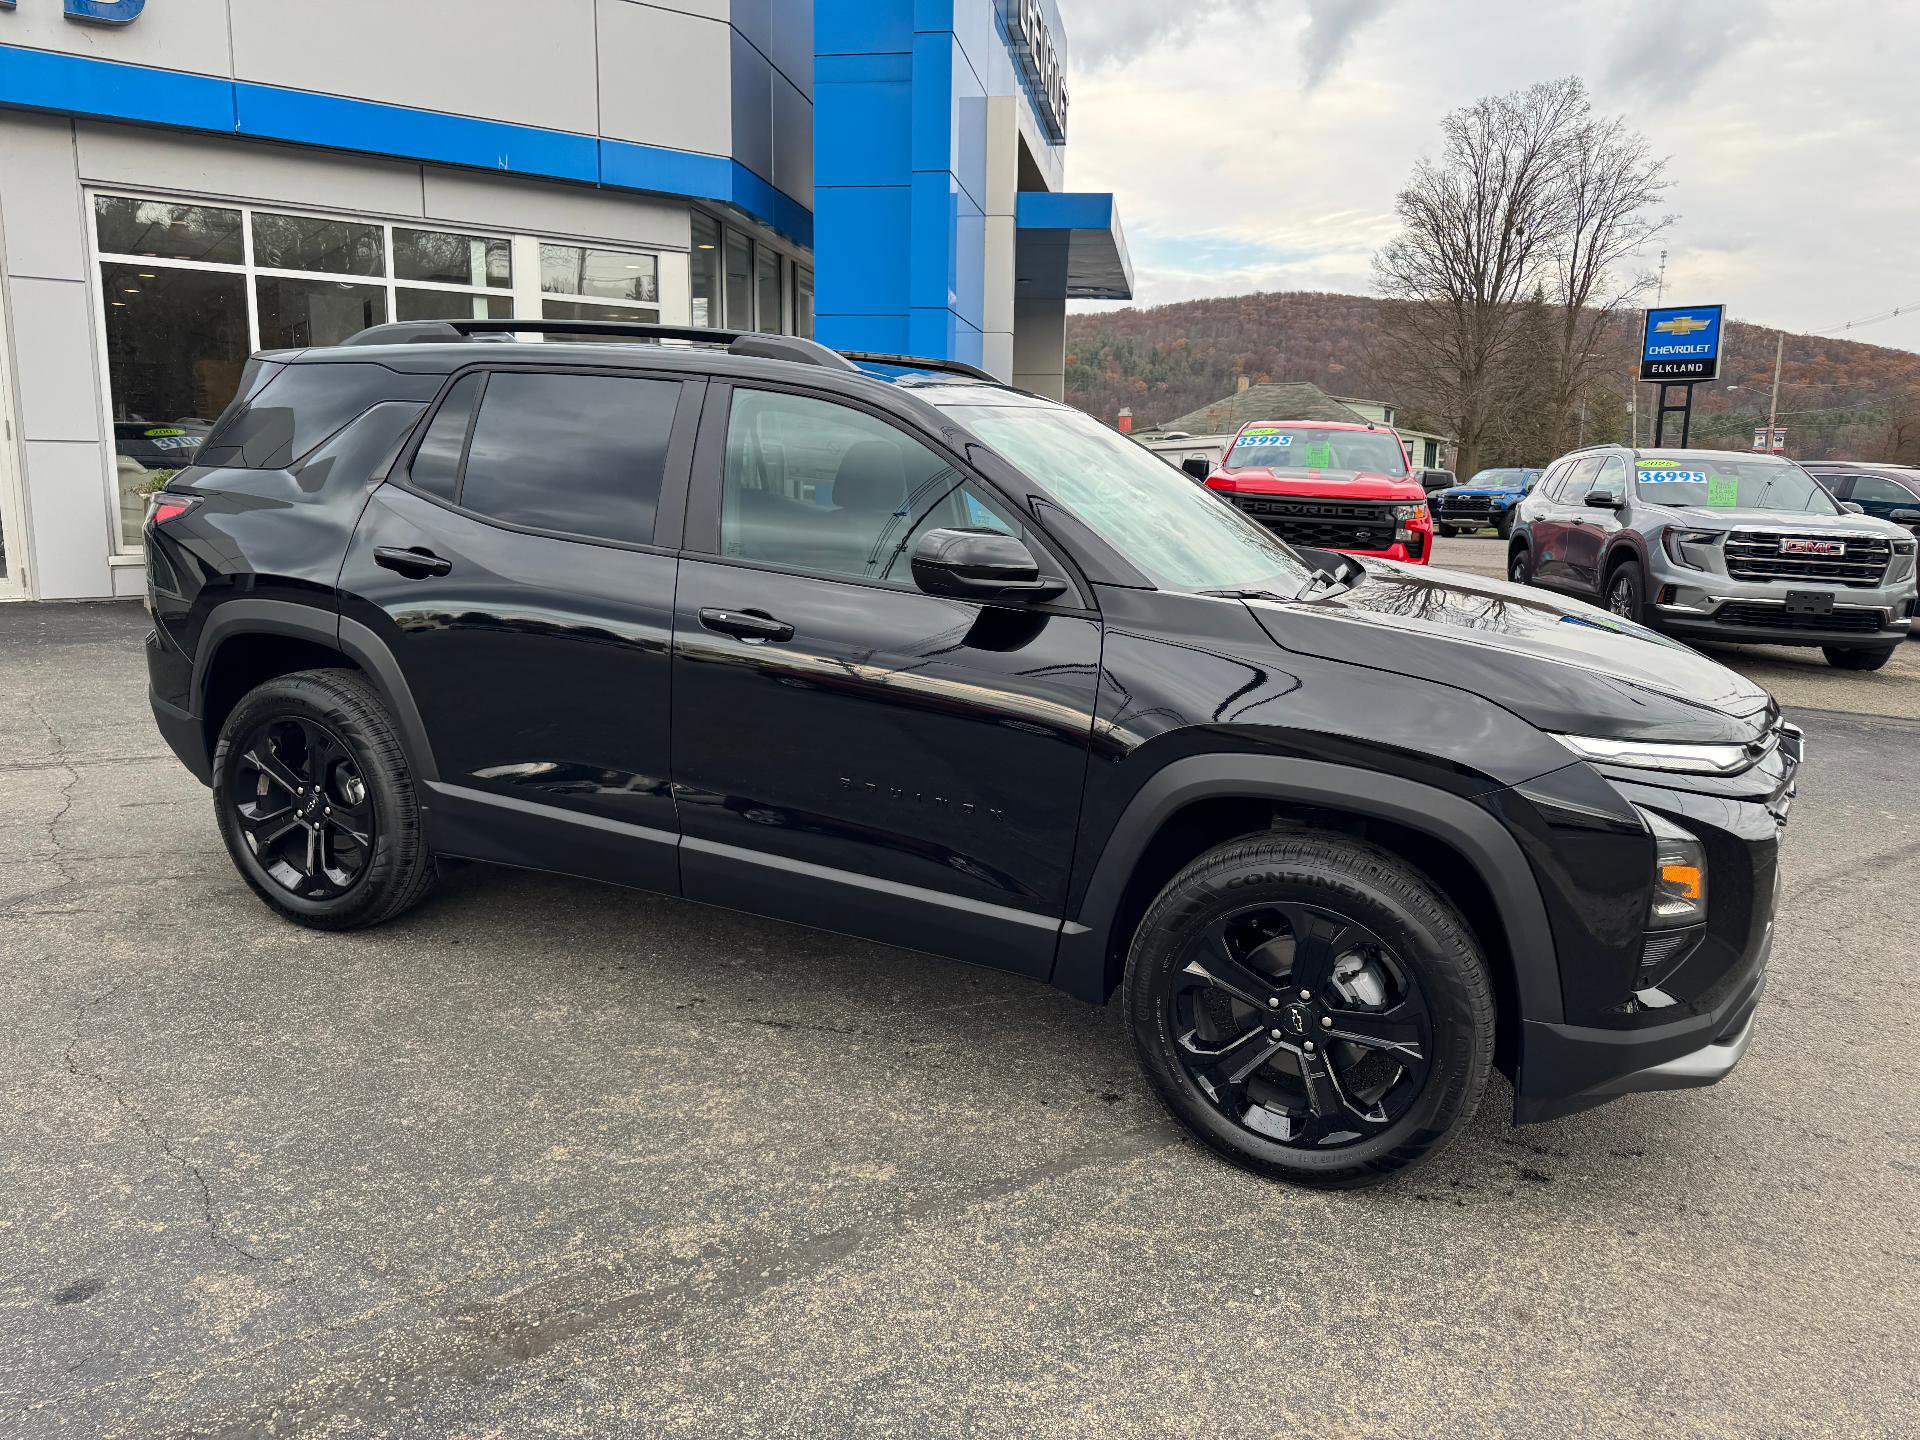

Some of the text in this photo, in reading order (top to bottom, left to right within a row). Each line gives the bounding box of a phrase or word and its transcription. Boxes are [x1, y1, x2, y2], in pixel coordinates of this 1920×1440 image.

[1649, 344, 1711, 355] CHEVROLET
[1651, 363, 1703, 373] ELKLAND
[1236, 436, 1291, 447] 35995
[1639, 471, 1705, 483] 36995
[1239, 501, 1386, 519] CHEVROLET
[1786, 541, 1842, 555] GMC
[1226, 871, 1396, 922] CONTINENT
